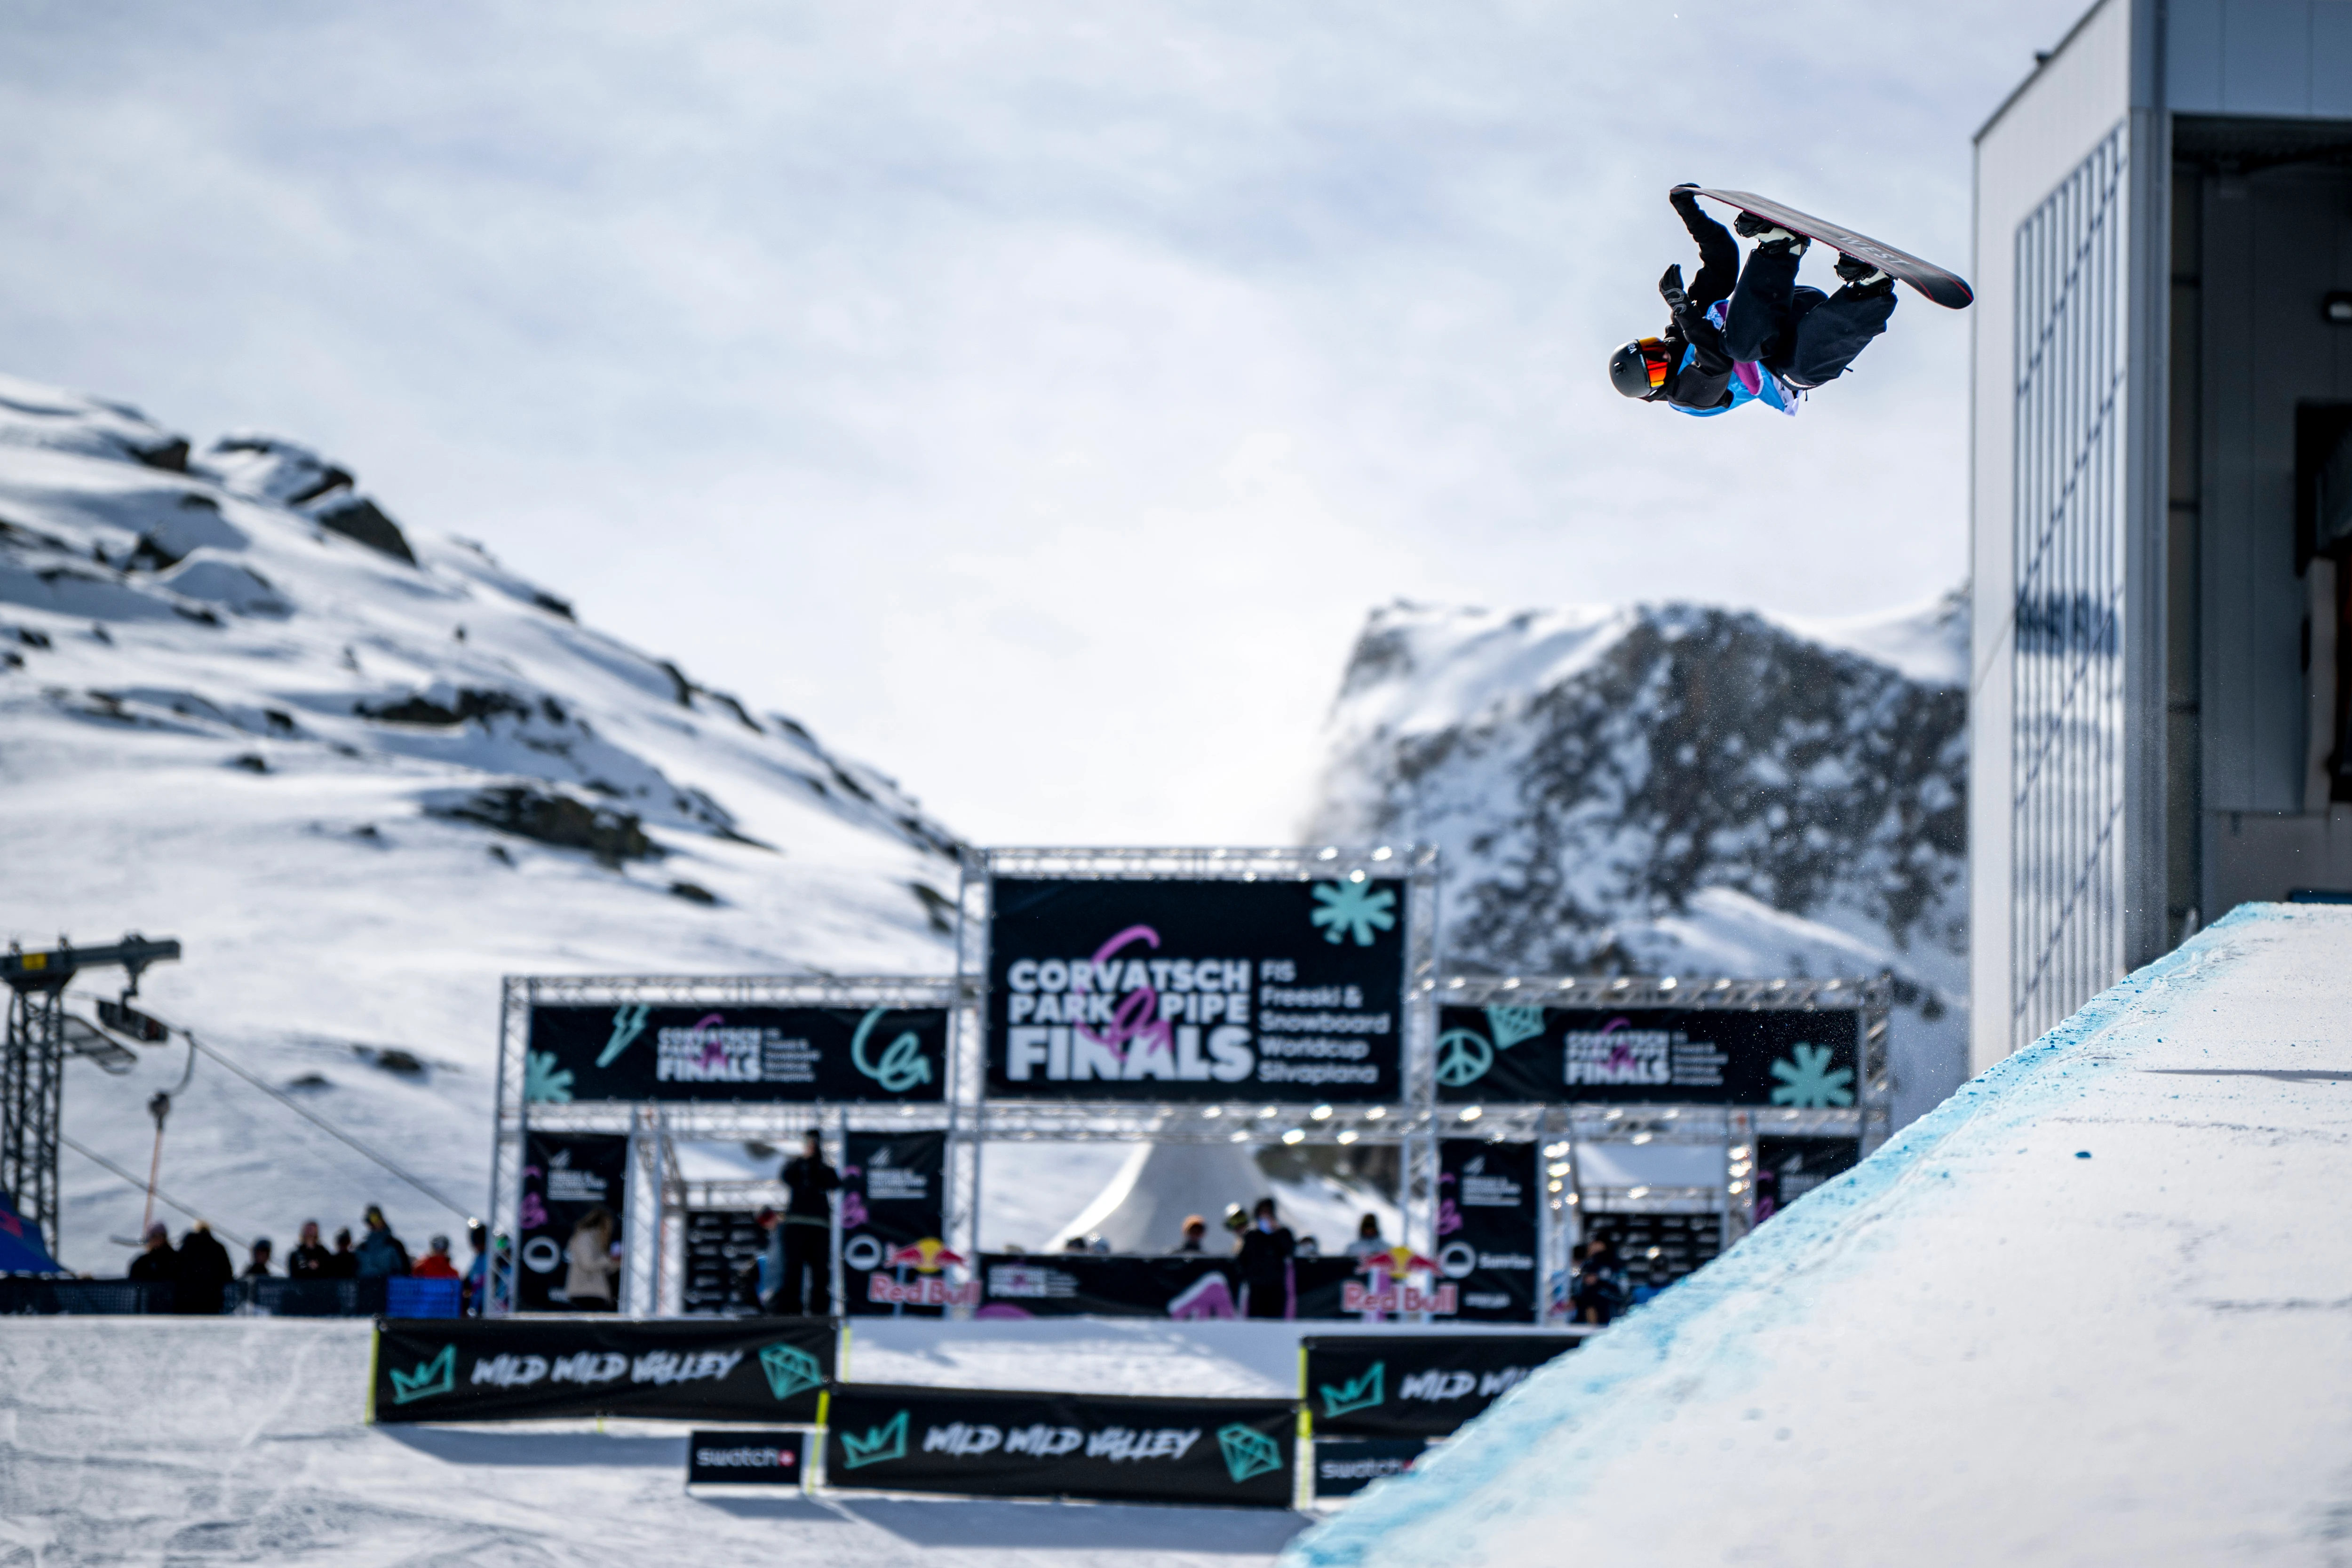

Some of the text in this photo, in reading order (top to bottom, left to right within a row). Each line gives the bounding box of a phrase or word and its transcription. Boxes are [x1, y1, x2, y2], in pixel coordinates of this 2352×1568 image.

[1840, 237, 1910, 264] WEST
[1008, 959, 1251, 992] CORVATSCH
[1260, 960, 1296, 982] FIS
[1008, 993, 1250, 1024] PARK PIPE
[1260, 985, 1362, 1008] Freeski &
[1260, 1011, 1391, 1034] Snowboard
[1007, 1026, 1255, 1082] FINALS
[1259, 1035, 1369, 1060] Worldcup
[1258, 1060, 1379, 1085] Silvaplana
[869, 1274, 922, 1304] Red
[930, 1278, 981, 1306] Bull
[1343, 1283, 1398, 1311] Red
[1405, 1283, 1457, 1313] Bull
[470, 1349, 743, 1387] WILD WILD VALLEY
[1399, 1369, 1477, 1401] WILD
[922, 1422, 1201, 1461] WILD WILD VALLEY
[697, 1447, 779, 1467] swatch
